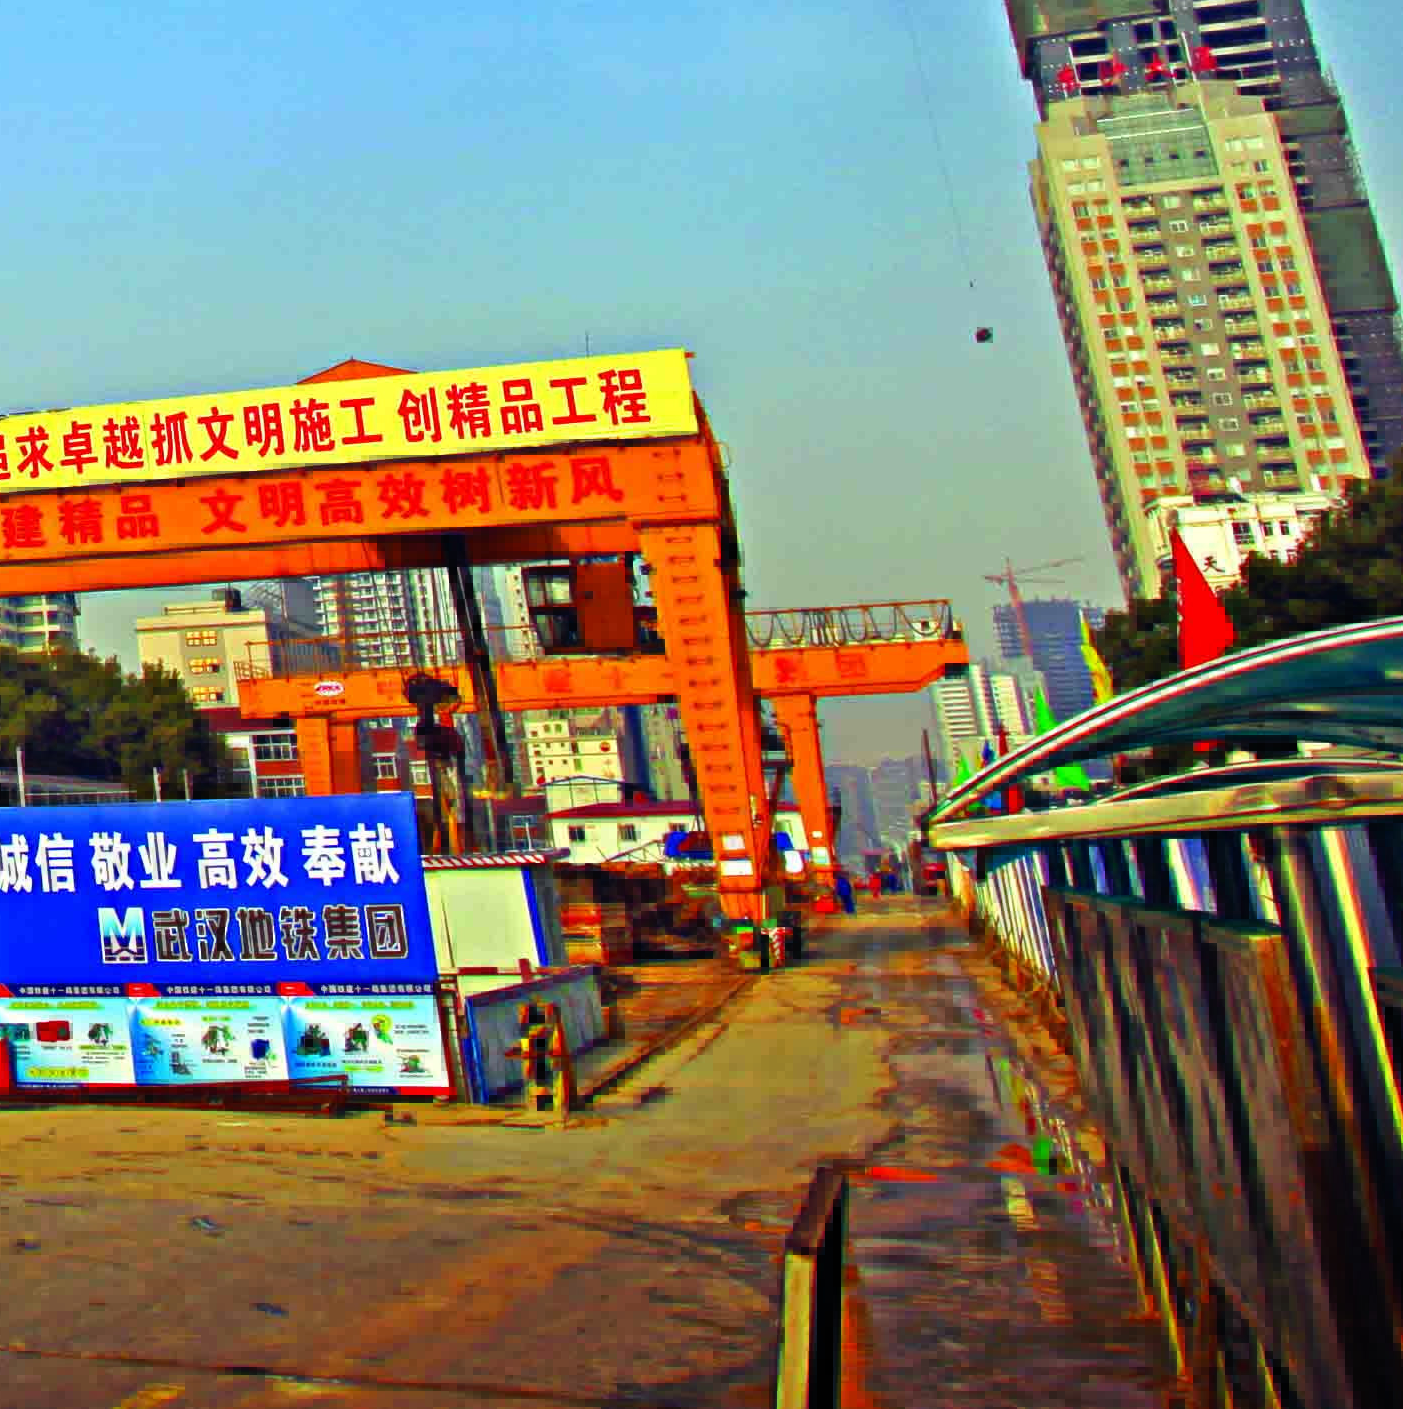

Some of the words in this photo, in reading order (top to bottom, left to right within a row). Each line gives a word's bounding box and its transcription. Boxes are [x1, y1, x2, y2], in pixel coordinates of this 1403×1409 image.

[199, 456, 625, 536] 文明高效树新风
[89, 831, 182, 891] 敬业
[192, 827, 289, 890] 高效
[300, 822, 401, 886] 奉献
[152, 904, 409, 962] 武汉地铁集团
